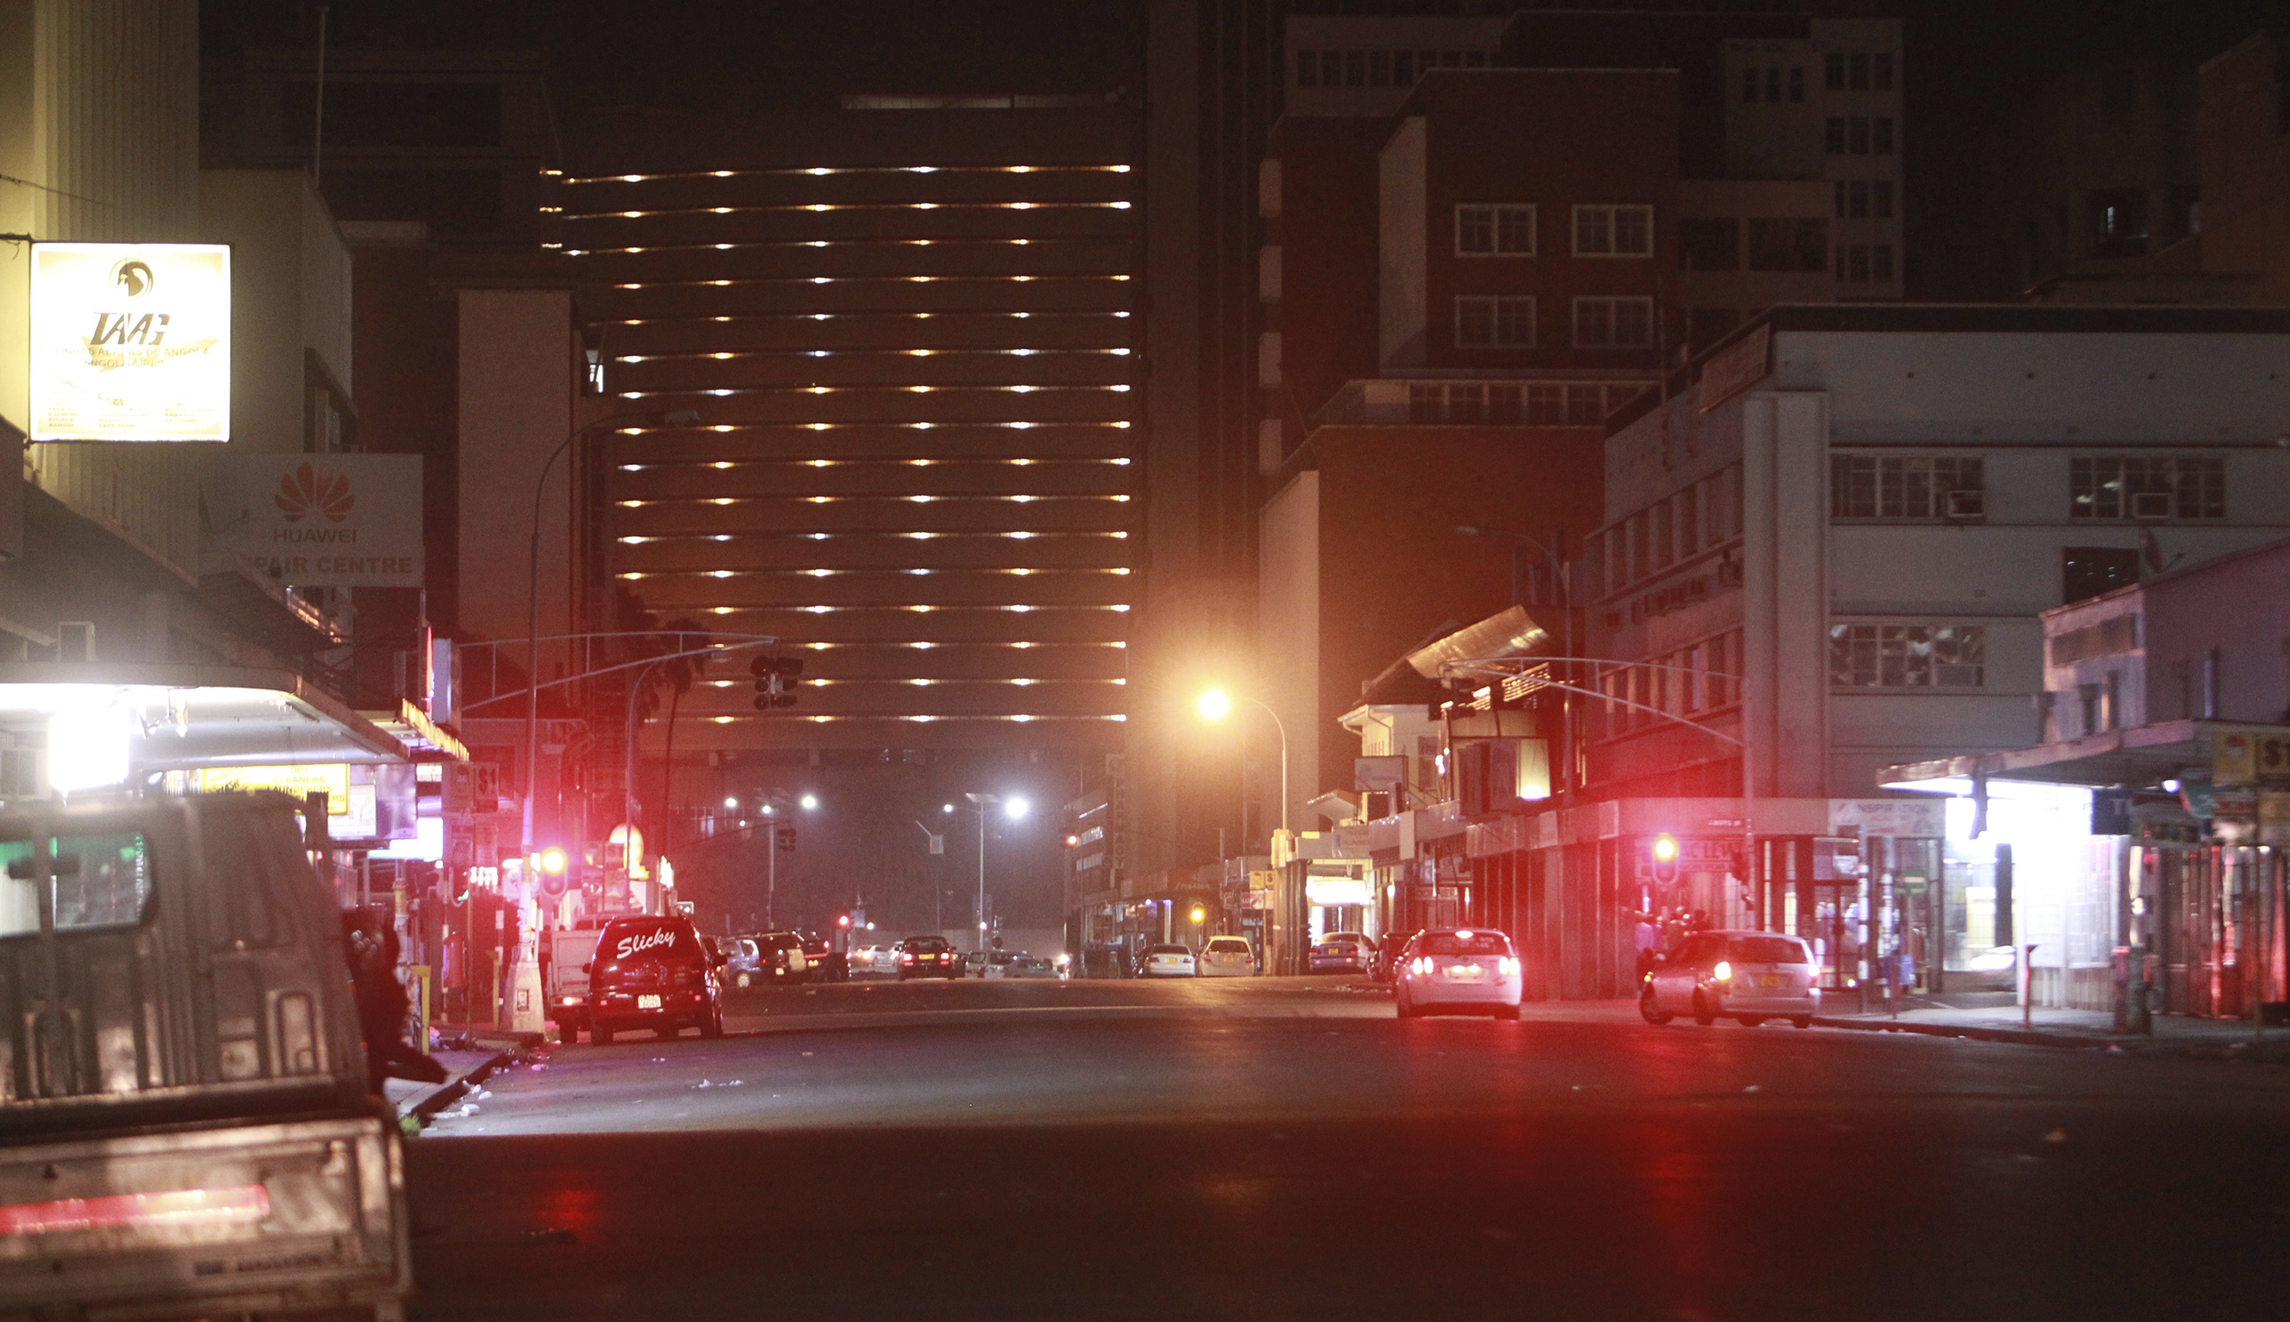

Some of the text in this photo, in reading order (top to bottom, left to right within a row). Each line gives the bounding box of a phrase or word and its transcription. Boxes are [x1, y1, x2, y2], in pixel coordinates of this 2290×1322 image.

[90, 312, 170, 345] TAAG
[273, 528, 357, 544] HUAWEI
[317, 556, 412, 574] CENTRE
[616, 927, 676, 960] Slicky
